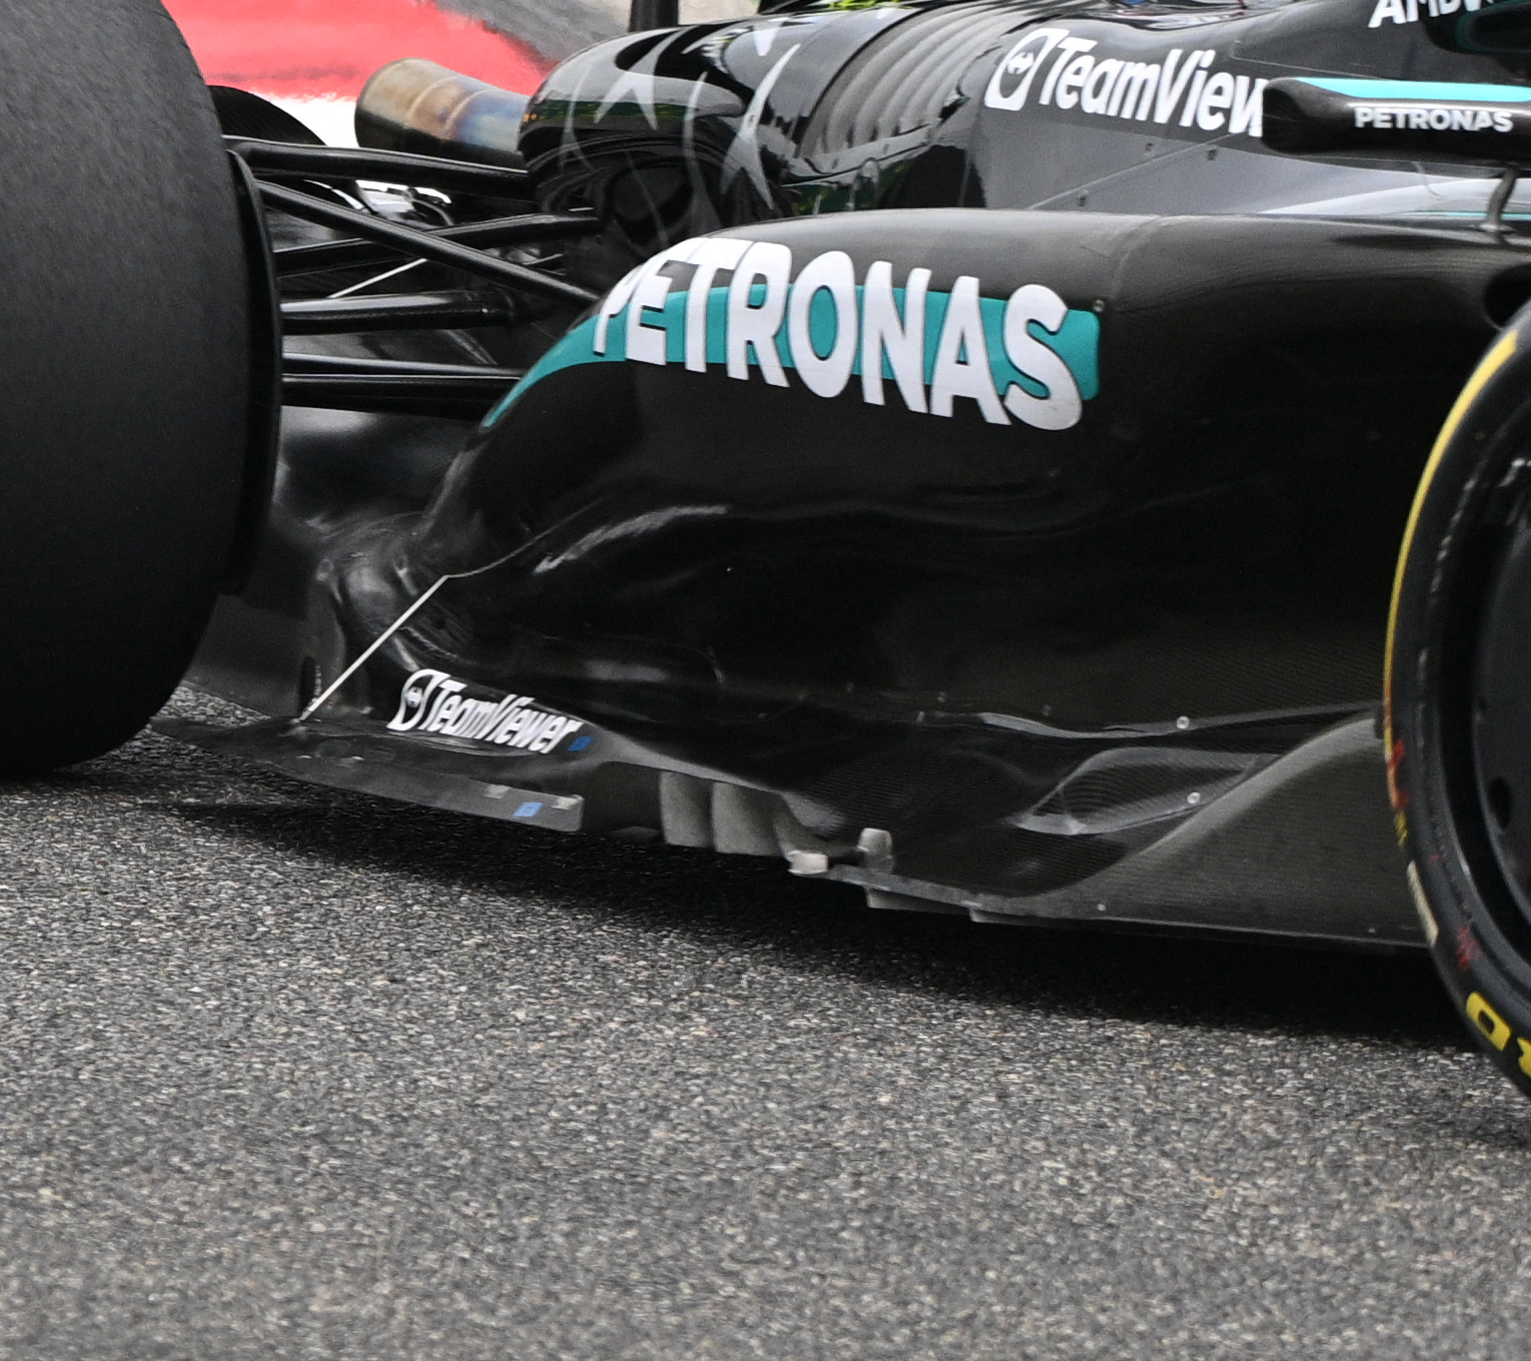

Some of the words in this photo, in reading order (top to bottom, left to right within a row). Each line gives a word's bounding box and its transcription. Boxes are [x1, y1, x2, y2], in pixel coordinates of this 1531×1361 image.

[1037, 36, 1266, 140] TeamView
[1353, 105, 1513, 133] PETRONAS
[591, 236, 1085, 431] PETRONAS
[417, 678, 584, 754] TeamViewer
